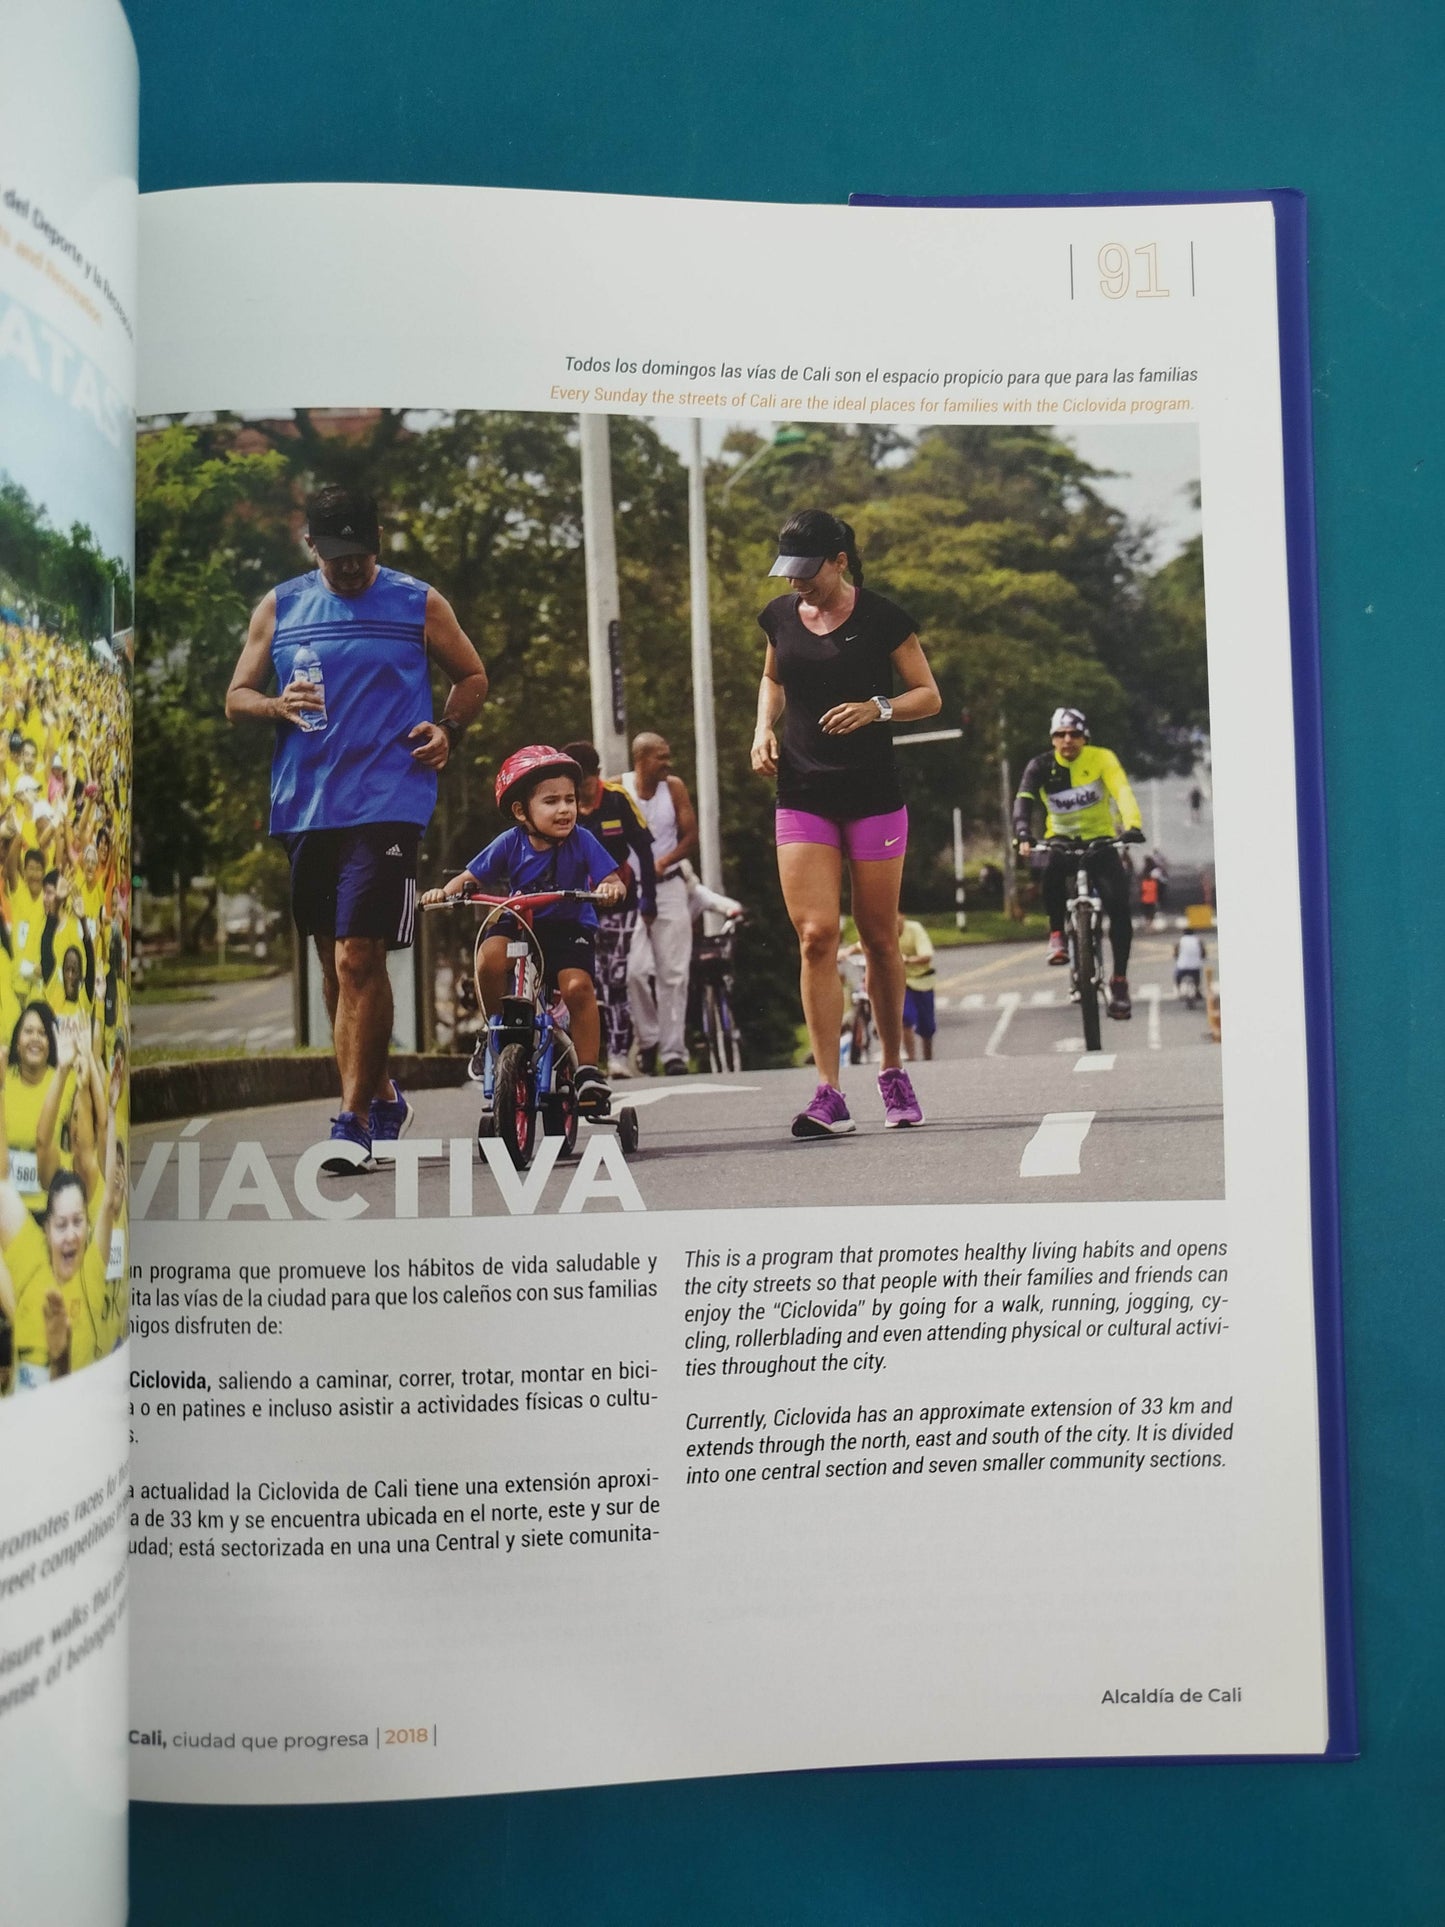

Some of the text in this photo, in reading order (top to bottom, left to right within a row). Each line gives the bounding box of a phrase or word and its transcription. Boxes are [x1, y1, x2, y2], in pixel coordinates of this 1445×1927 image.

[32, 207, 83, 267] Deporte
[1097, 242, 1170, 300] 91
[565, 356, 1198, 388] Todos los domingos las vías de Cali son el espacio propicio para que para las familias
[550, 385, 1193, 414] Every Sunday the streets of Cali are the ideal places for families with the Ciclovida program.
[150, 1266, 230, 1284] programa
[239, 1266, 270, 1284] que
[279, 1265, 366, 1284] promueve
[374, 1259, 400, 1278] los
[408, 1258, 474, 1277] hábitos
[482, 1256, 504, 1275] de
[511, 1255, 548, 1274] vida
[556, 1252, 640, 1273] saludable
[648, 1256, 657, 1274] y
[685, 1239, 1228, 1270] This is a program that promotes healthy living habits and opens
[132, 1288, 151, 1306] ita
[156, 1288, 179, 1307] las
[184, 1289, 218, 1307] vías
[223, 1288, 243, 1307] de
[248, 1288, 262, 1307] la
[267, 1287, 326, 1307] ciudad
[331, 1292, 370, 1311] para
[375, 1291, 408, 1310] que
[413, 1286, 438, 1305] los
[443, 1284, 512, 1304] caleños
[516, 1287, 548, 1302] con
[553, 1286, 584, 1300] sus
[588, 1279, 657, 1299] familias
[685, 1291, 1228, 1326] enjoy the “Ciclovida” by going for a walk, running, jogging, cy-
[175, 1315, 251, 1335] disfruten
[257, 1315, 282, 1335] de:
[130, 1360, 658, 1393] Ciclovida, saliendo a caminar, correr, trotar, montar en bici-
[685, 1352, 886, 1378] ties throughout the city.
[686, 1396, 1233, 1432] Currently, Ciclovida has an approximate extension of 33 km and
[686, 1449, 1226, 1484] into one central section and seven smaller community sections.
[141, 1468, 659, 1501] actualidad la Ciclovida de Cali tiene una extensión aproxi-
[179, 1538, 215, 1557] está
[221, 1537, 324, 1557] sectorizada
[330, 1541, 351, 1555] en
[358, 1540, 390, 1555] una
[397, 1538, 430, 1553] una
[436, 1530, 499, 1552] Central
[505, 1535, 515, 1553] y
[521, 1528, 563, 1548] siete
[569, 1523, 660, 1545] comunita-
[1101, 1687, 1242, 1704] Alcaldía de Cali
[129, 1728, 428, 1752] Cali, ciudad que progresa 2018
